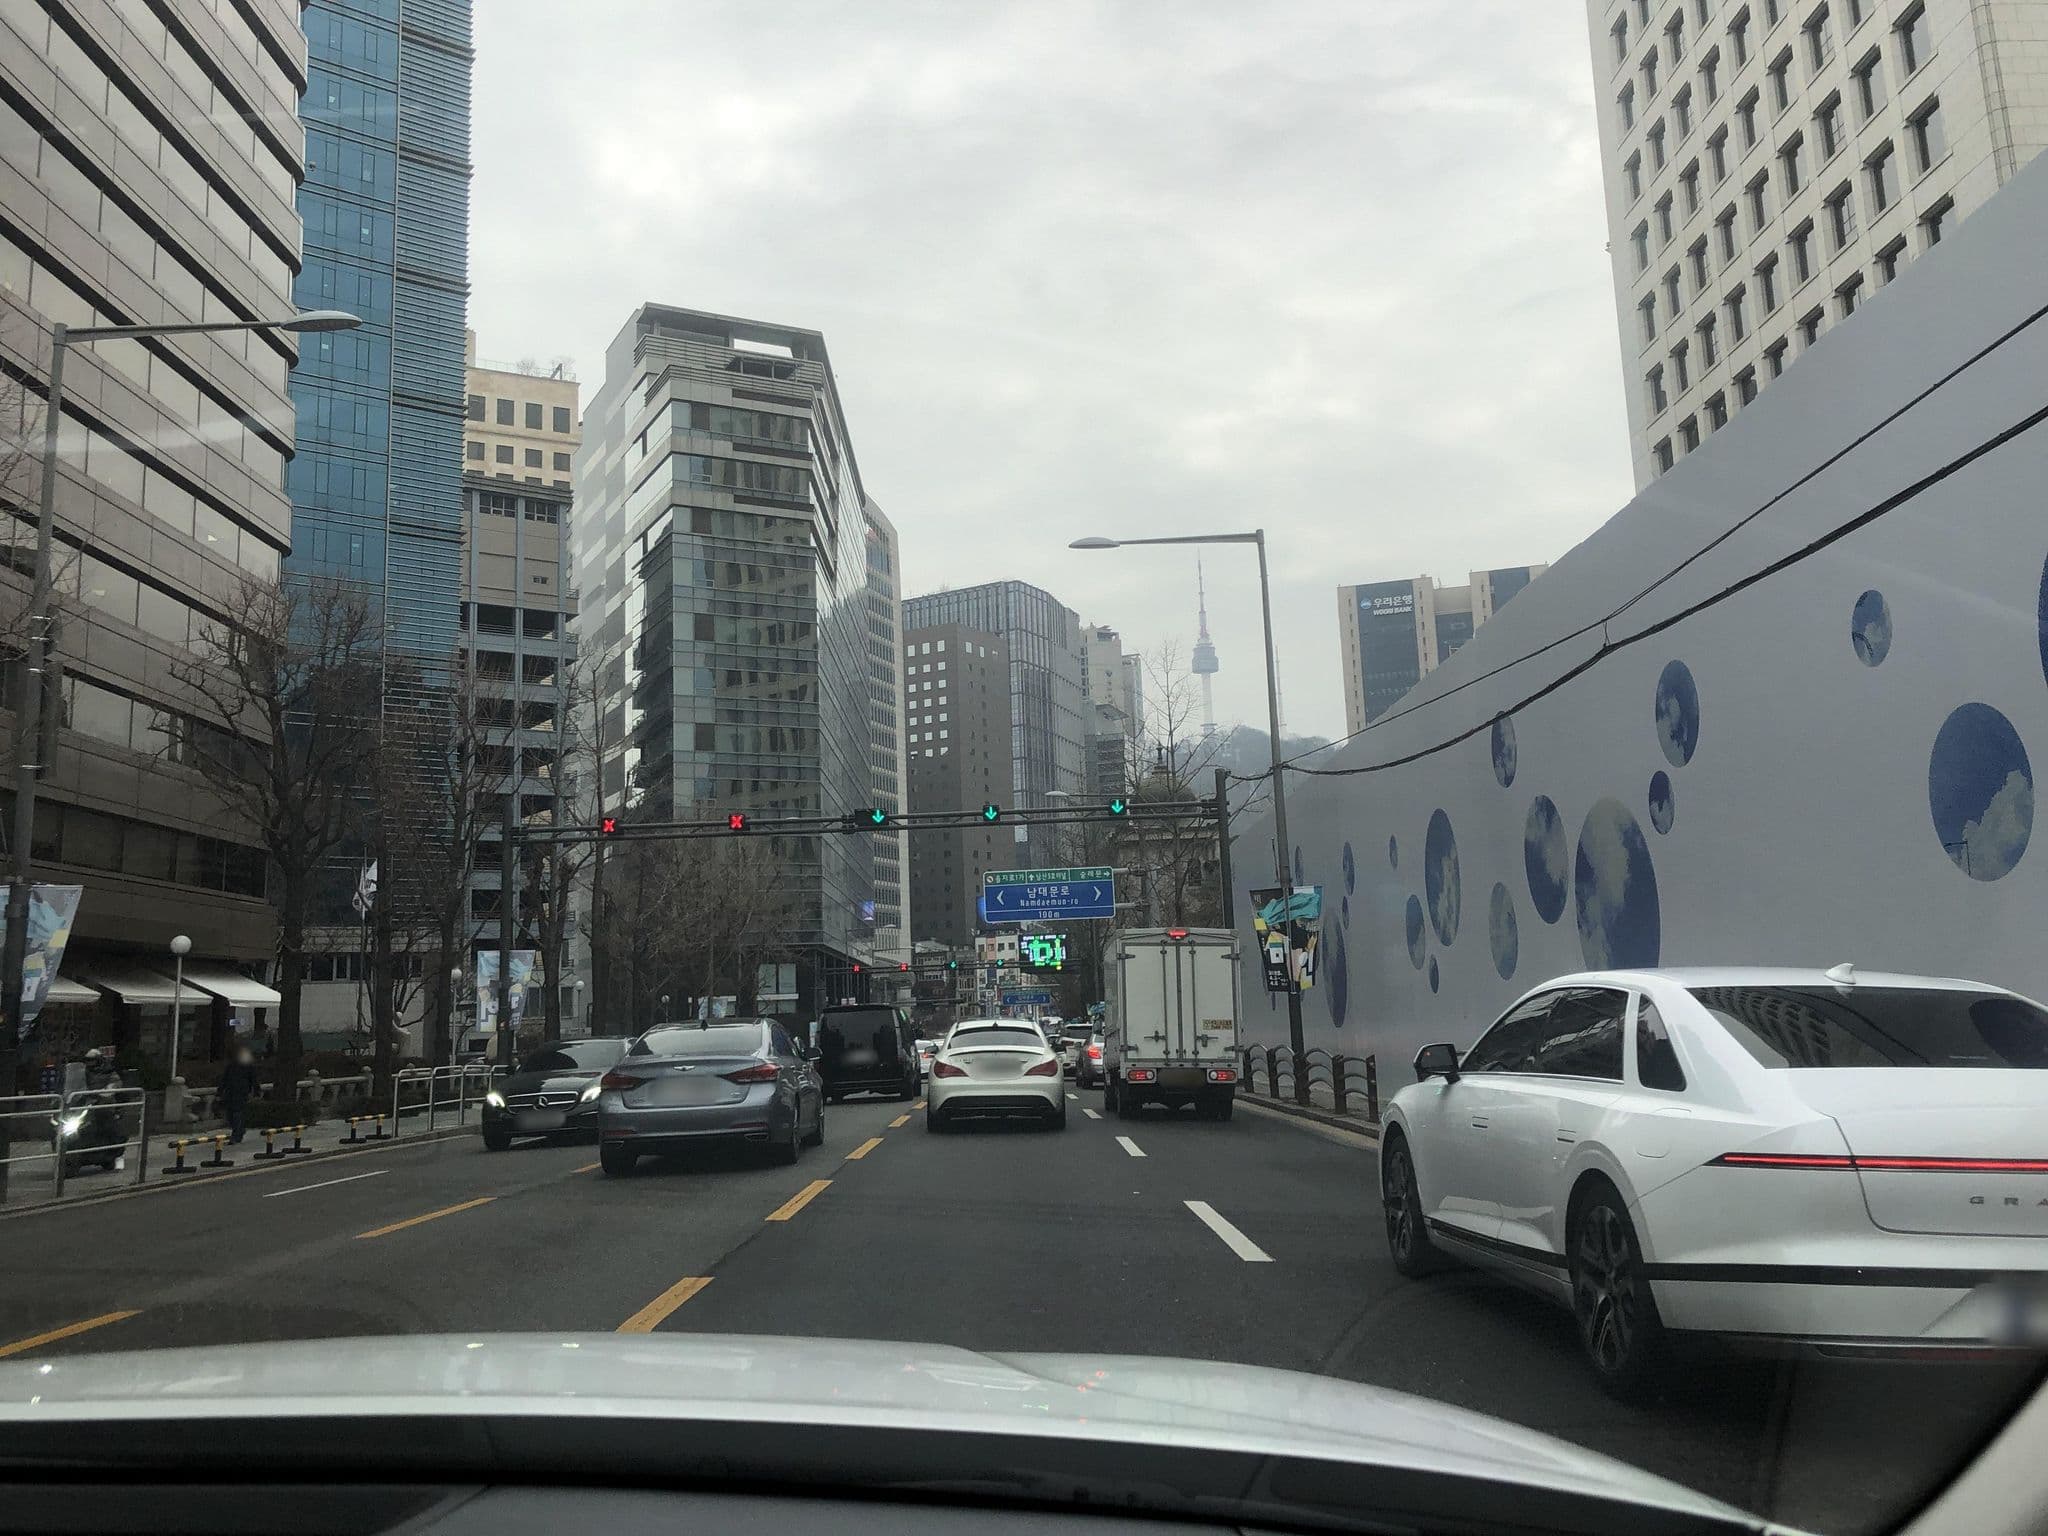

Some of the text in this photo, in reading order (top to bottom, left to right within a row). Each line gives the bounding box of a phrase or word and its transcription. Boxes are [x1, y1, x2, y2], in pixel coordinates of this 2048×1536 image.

[1373, 595, 1412, 608] 우리은행
[1394, 606, 1413, 614] BANK
[1027, 886, 1070, 898] 남대문로
[1020, 899, 1079, 907] Namdaemun-ro
